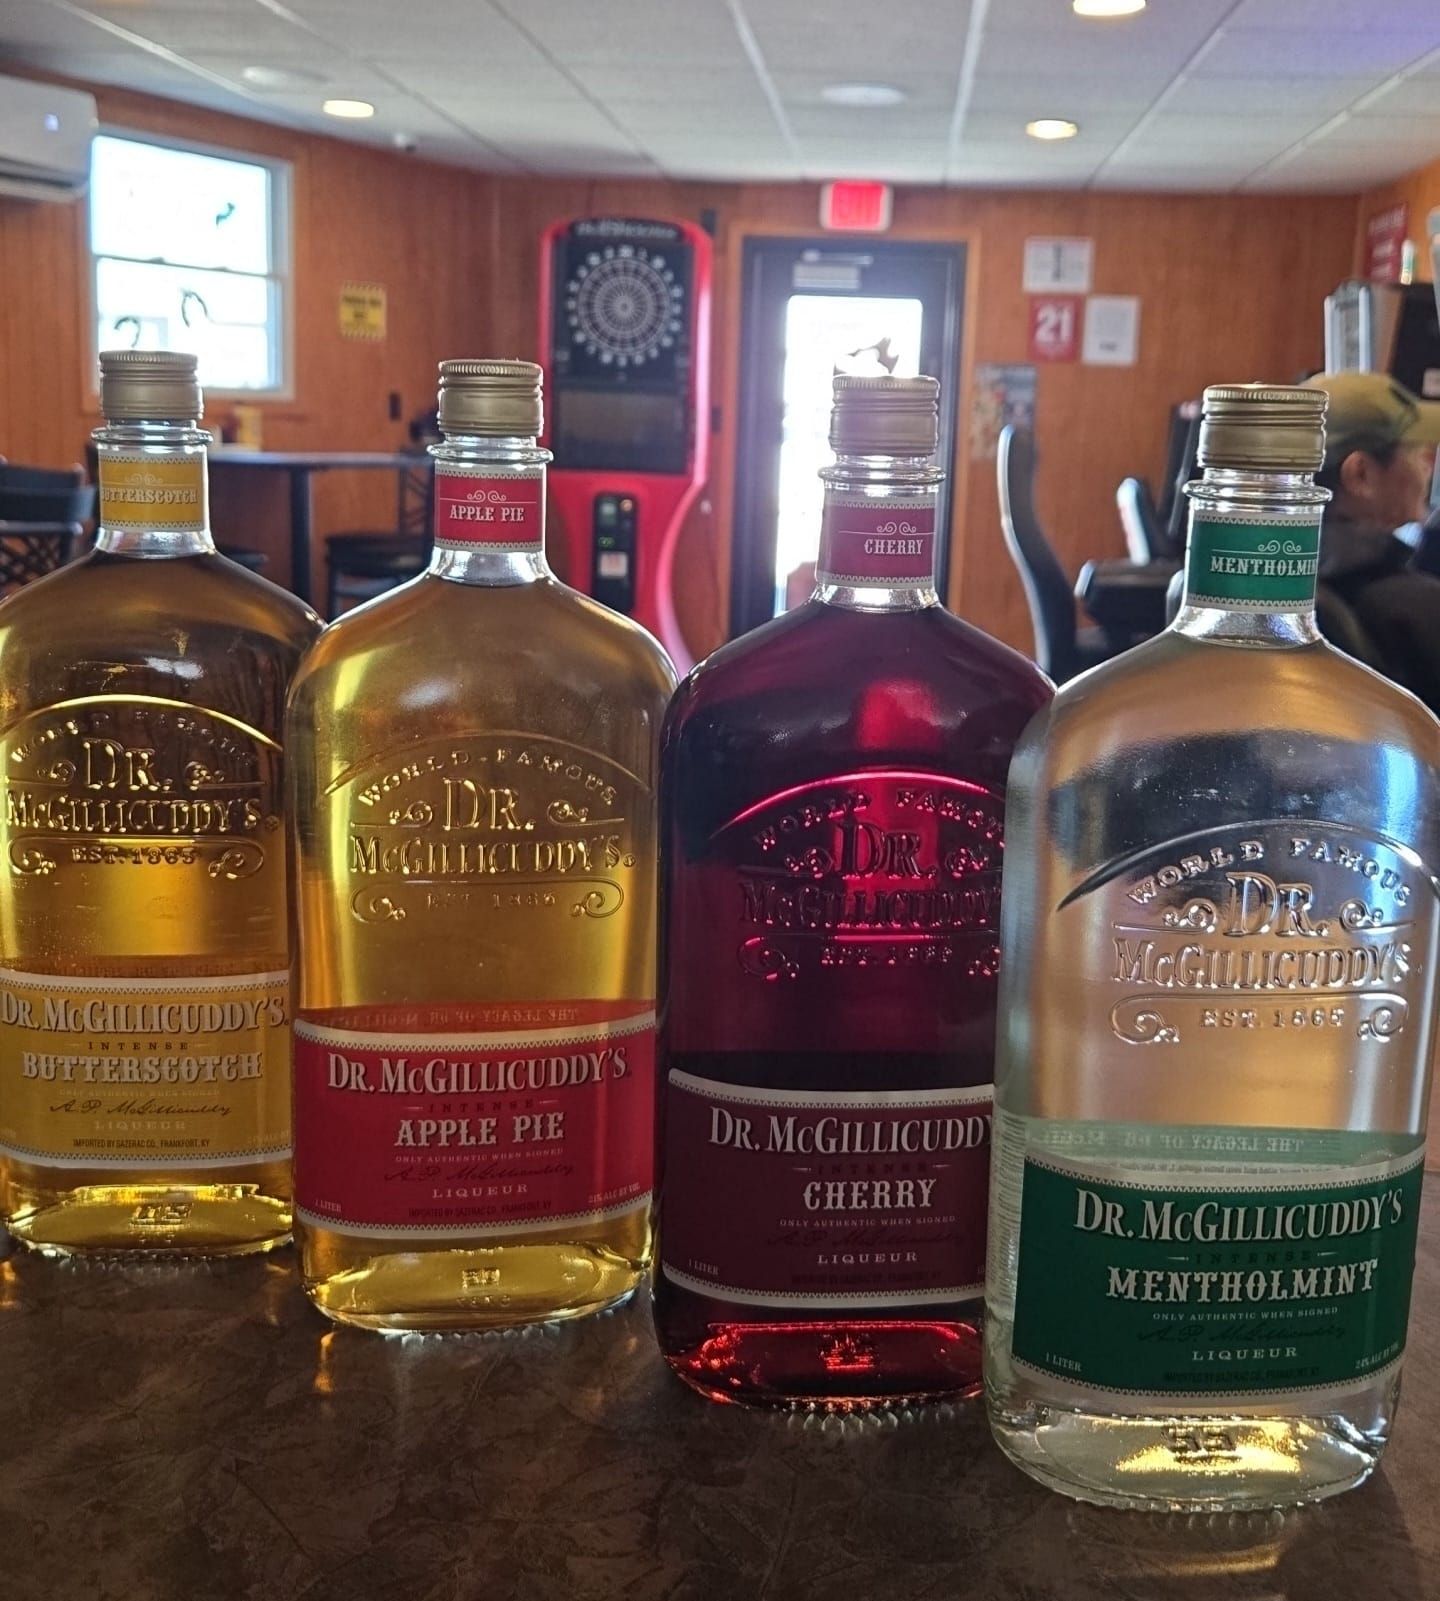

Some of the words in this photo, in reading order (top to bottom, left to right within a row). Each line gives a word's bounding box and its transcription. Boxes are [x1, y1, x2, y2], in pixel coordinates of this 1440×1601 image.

[1035, 304, 1072, 343] 21
[450, 505, 494, 521] APPLE
[501, 507, 524, 522] PIE
[864, 539, 924, 554] CHERRY
[442, 777, 534, 831] DR.
[835, 819, 939, 880] DR.
[1127, 840, 1264, 905] WORLD
[1290, 838, 1411, 906] FAMOUS
[1224, 872, 1329, 936] DR.
[1, 990, 39, 1031] DR.
[1272, 1006, 1344, 1028] 1865
[88, 1041, 190, 1050] INTENSE
[22, 1052, 263, 1083] BUTTERSCOTCH
[327, 1052, 375, 1092] DR.
[429, 1099, 534, 1113] INTENSE
[94, 1120, 187, 1130] LIQUEUR
[394, 1117, 497, 1147] APPLE
[512, 1111, 565, 1144] PIE
[709, 1106, 761, 1151] DR.
[73, 1139, 105, 1148] IMPORTED
[106, 1139, 115, 1148] BY
[395, 1155, 422, 1163] ONLY
[427, 1154, 488, 1163] AUTHENTIC
[491, 1152, 522, 1160] WHEN
[525, 1148, 564, 1159] SIGNED
[432, 1183, 529, 1199] LIQUEUR
[803, 1179, 937, 1211] CHERRY
[320, 1199, 342, 1213] LITER
[1073, 1188, 1134, 1237] DR.
[779, 1219, 809, 1228] ONLY
[813, 1218, 876, 1228] AUTHENTIC
[880, 1217, 912, 1227] WHEN
[915, 1215, 956, 1225] SIGNED
[694, 1260, 719, 1275] LITER
[816, 1251, 918, 1265] LIQUEUR
[1106, 1258, 1378, 1303] MENTHOLMINT
[1152, 1312, 1185, 1321] ONLY
[1189, 1311, 1256, 1321] AUTHENTIC
[1260, 1310, 1293, 1320] WHEN
[1297, 1307, 1338, 1317] SIGNED
[1045, 1351, 1050, 1362] 1
[1052, 1354, 1082, 1373] LITER
[1191, 1346, 1297, 1361] LIQUEUR
